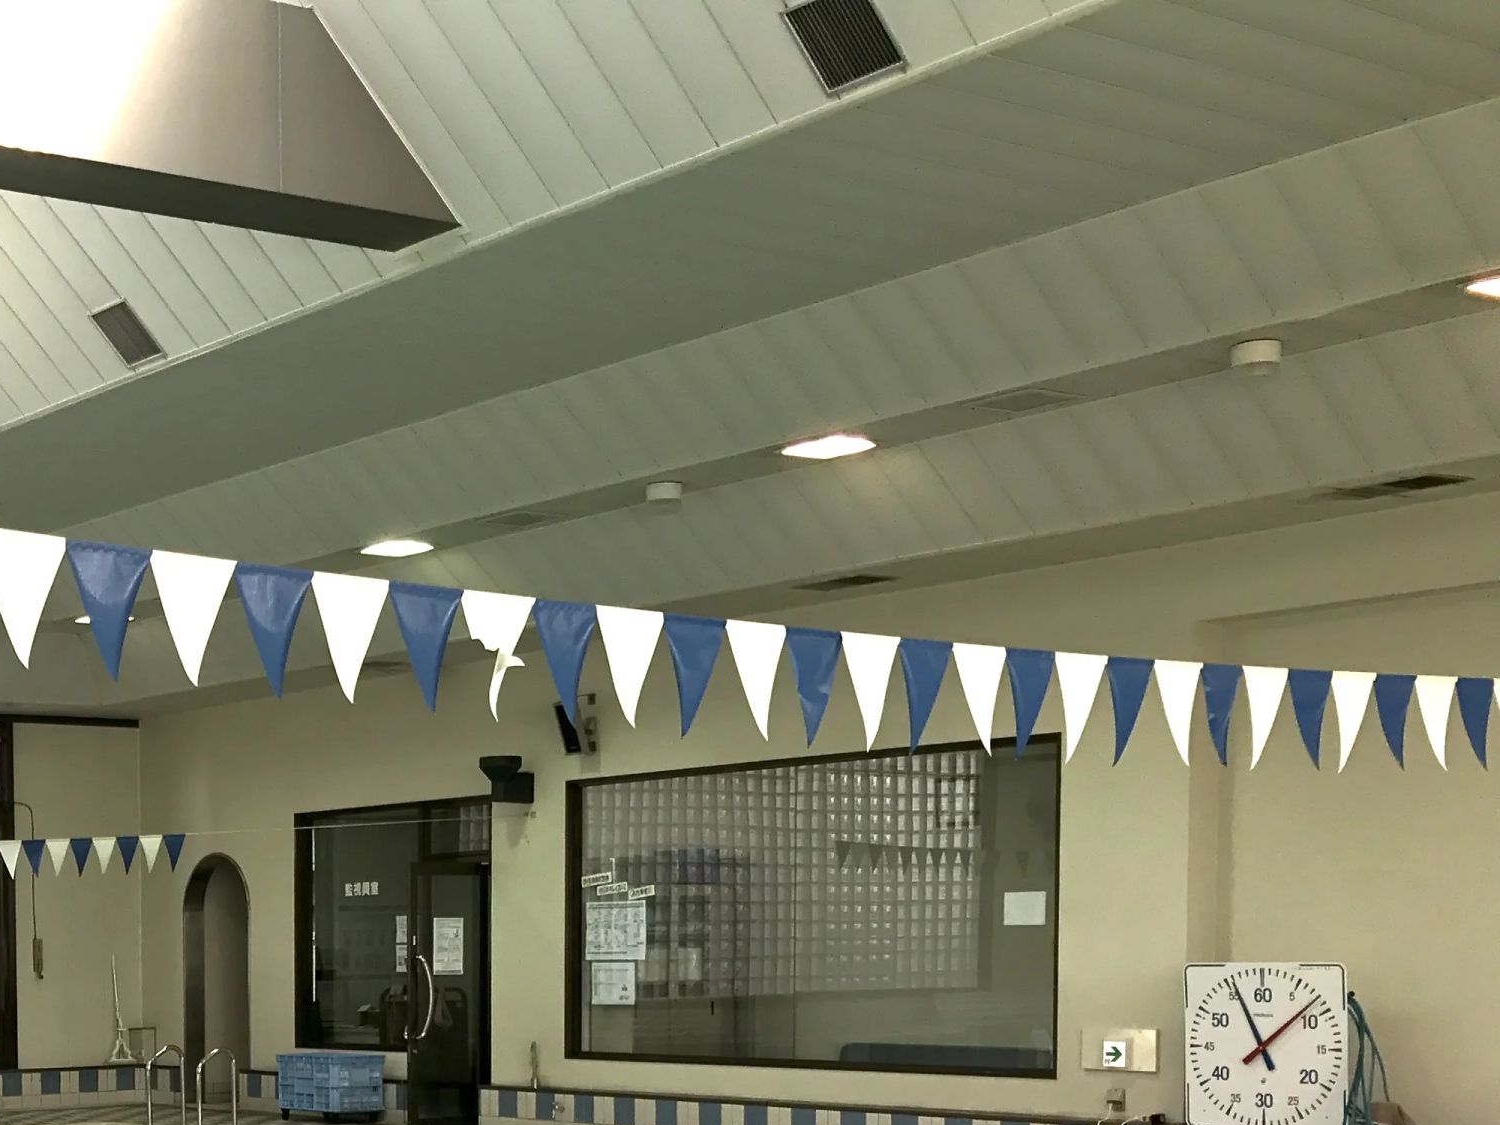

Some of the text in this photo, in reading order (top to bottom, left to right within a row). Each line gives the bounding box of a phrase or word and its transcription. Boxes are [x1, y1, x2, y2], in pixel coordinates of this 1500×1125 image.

[345, 882, 379, 896] 監視員室
[1254, 988, 1272, 1003] 60
[1289, 992, 1295, 1001] 5
[1212, 1013, 1229, 1028] 50
[1301, 1015, 1318, 1030] 10
[1204, 1042, 1215, 1051] 45
[1317, 1045, 1327, 1055] 15
[1212, 1066, 1230, 1081] 40
[1300, 1069, 1319, 1085] 20
[1231, 1094, 1241, 1103] 35
[1255, 1093, 1273, 1109] 30
[1288, 1096, 1299, 1106] 25
